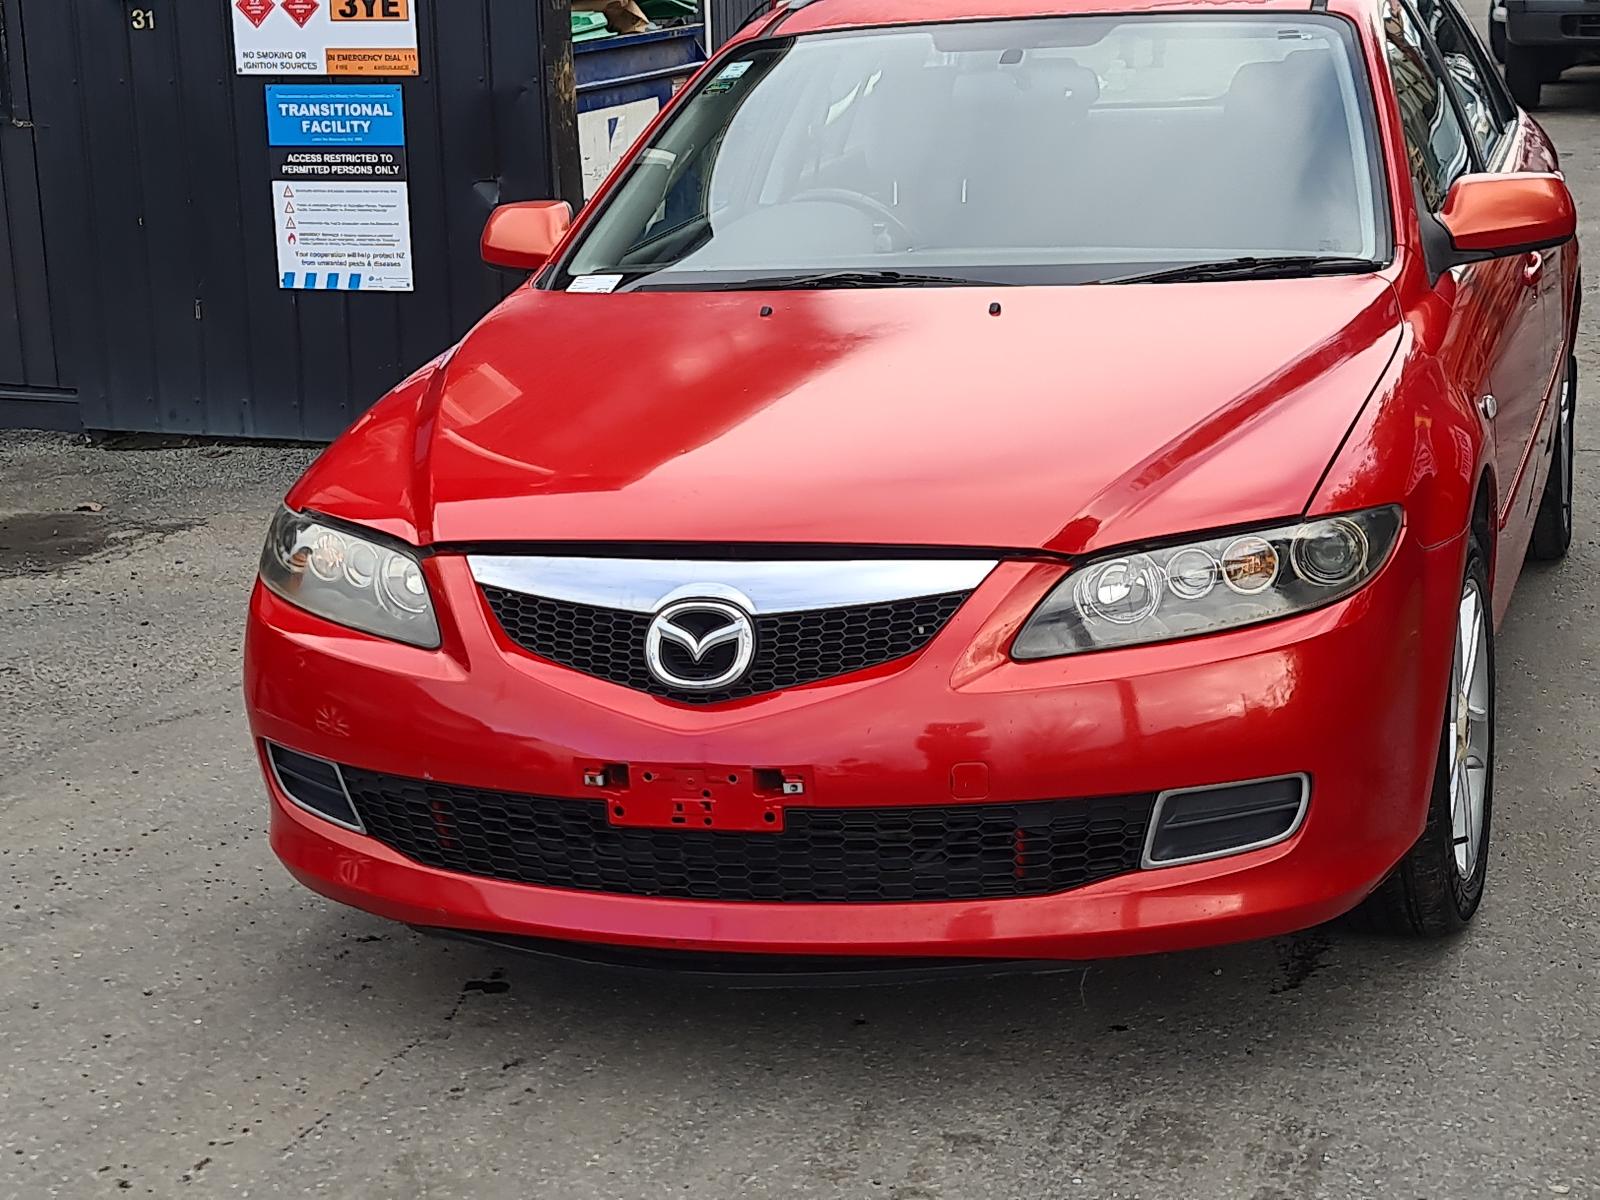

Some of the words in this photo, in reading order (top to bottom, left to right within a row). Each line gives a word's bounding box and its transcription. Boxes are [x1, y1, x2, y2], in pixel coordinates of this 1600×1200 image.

[338, 0, 401, 18] 3YE
[132, 9, 154, 29] 31
[242, 51, 255, 59] NO
[256, 51, 293, 59] SMOKING
[295, 51, 307, 60] OR
[243, 61, 278, 70] IGNITION
[280, 62, 318, 70] SOURCES
[278, 103, 393, 117] TRANSITIONAL
[301, 120, 371, 133] FACILITY
[287, 154, 322, 163] ACCESS
[323, 154, 379, 163] RESTRICTED
[381, 154, 394, 163] TO
[282, 165, 330, 174] PERMITTED
[331, 165, 373, 174] PERSONS
[374, 166, 400, 175] ONLY
